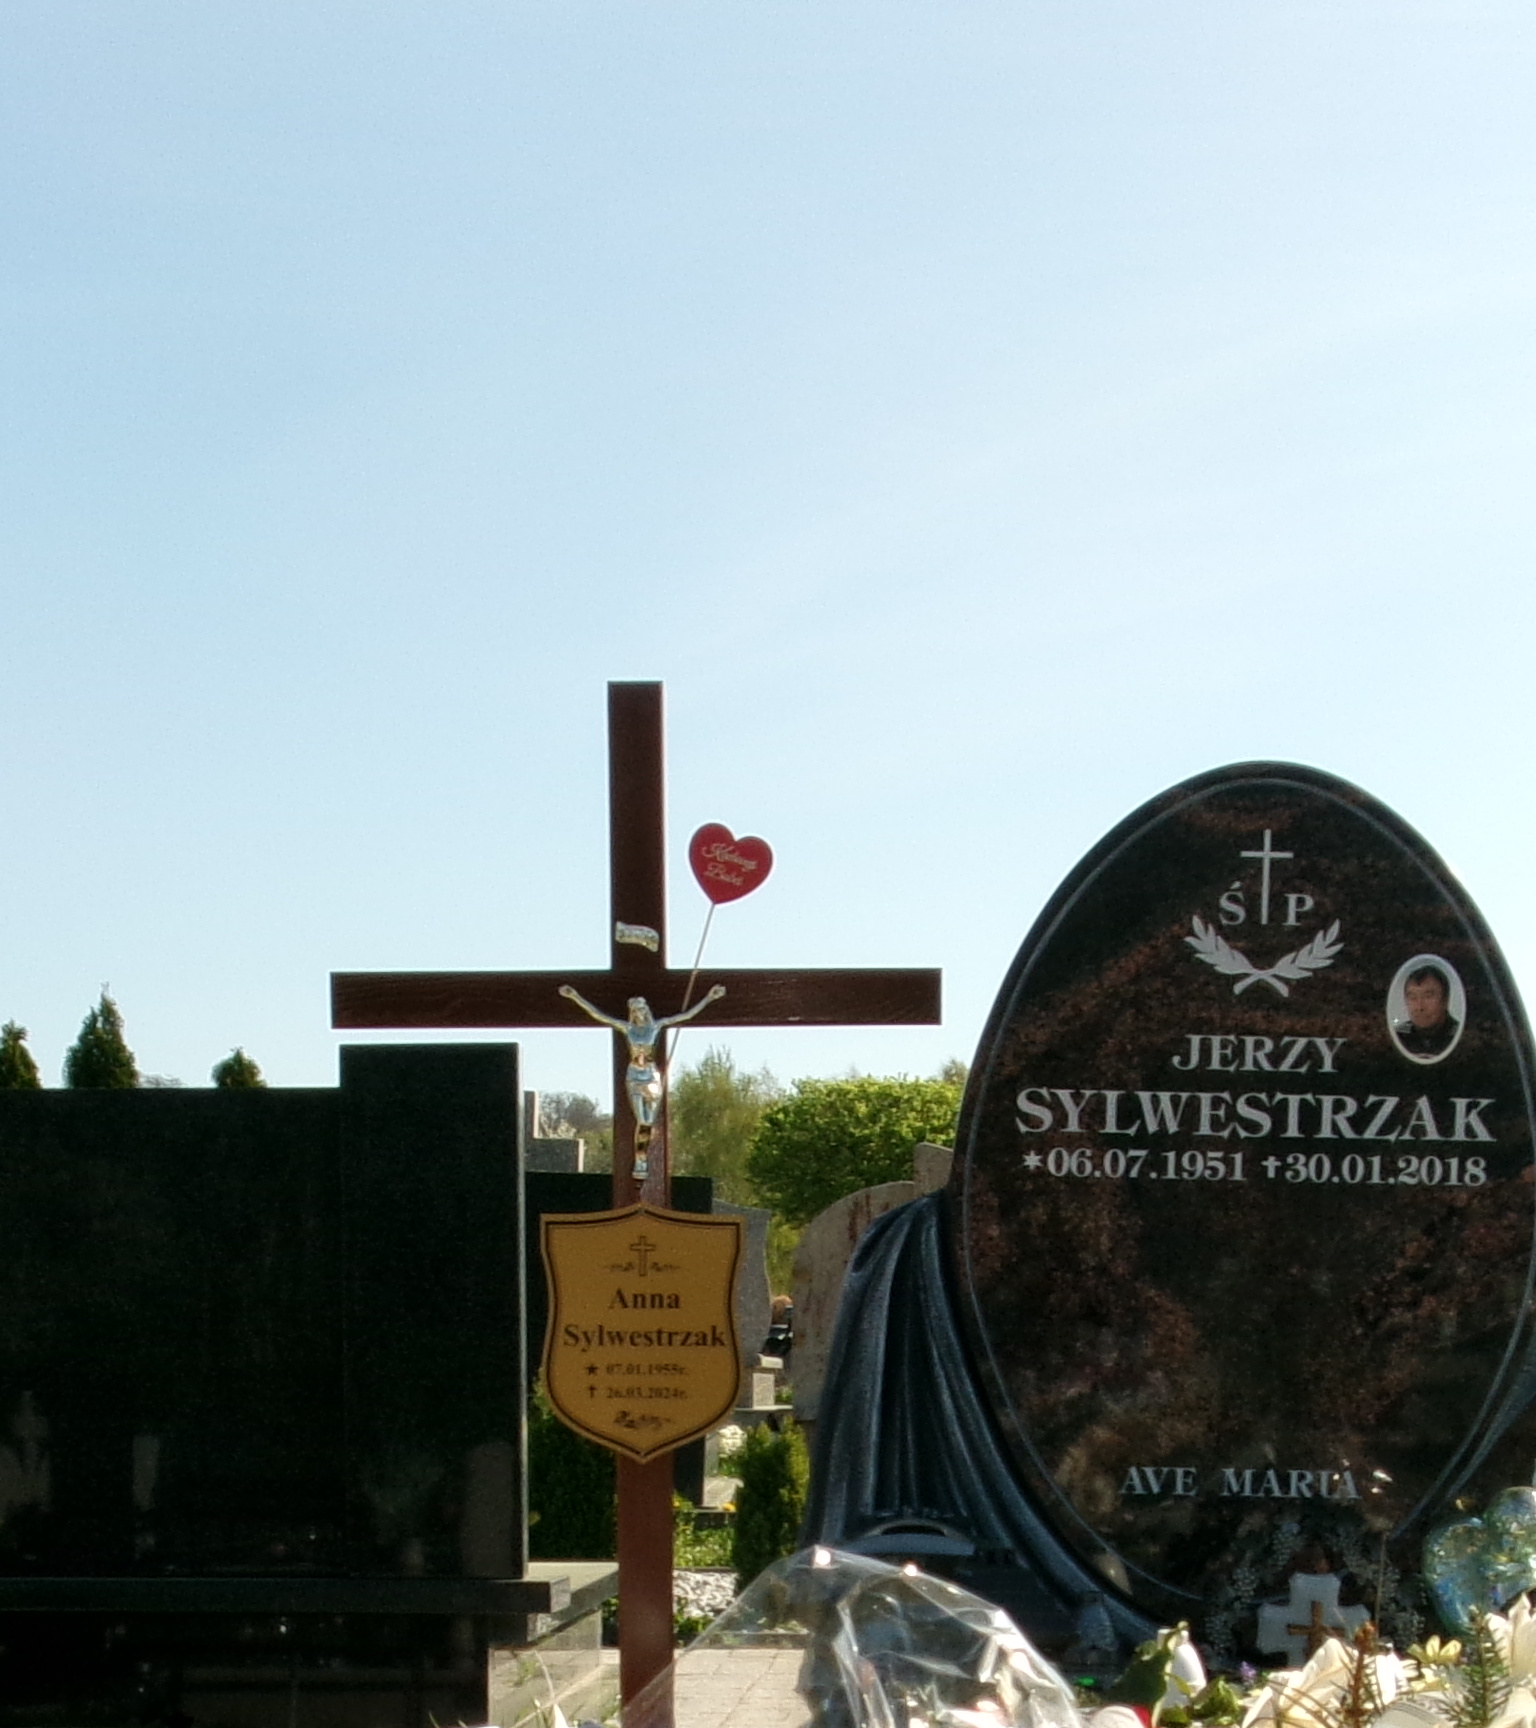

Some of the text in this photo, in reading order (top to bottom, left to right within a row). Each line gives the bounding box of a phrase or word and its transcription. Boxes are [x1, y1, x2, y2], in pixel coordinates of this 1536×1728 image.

[1170, 1033, 1348, 1074] JERZY
[1014, 1086, 1498, 1143] SYLWESTRZAK
[607, 1287, 681, 1310] Anna
[563, 1323, 726, 1353] Sylwestrzak
[1118, 1465, 1363, 1500] AVE MARIA
